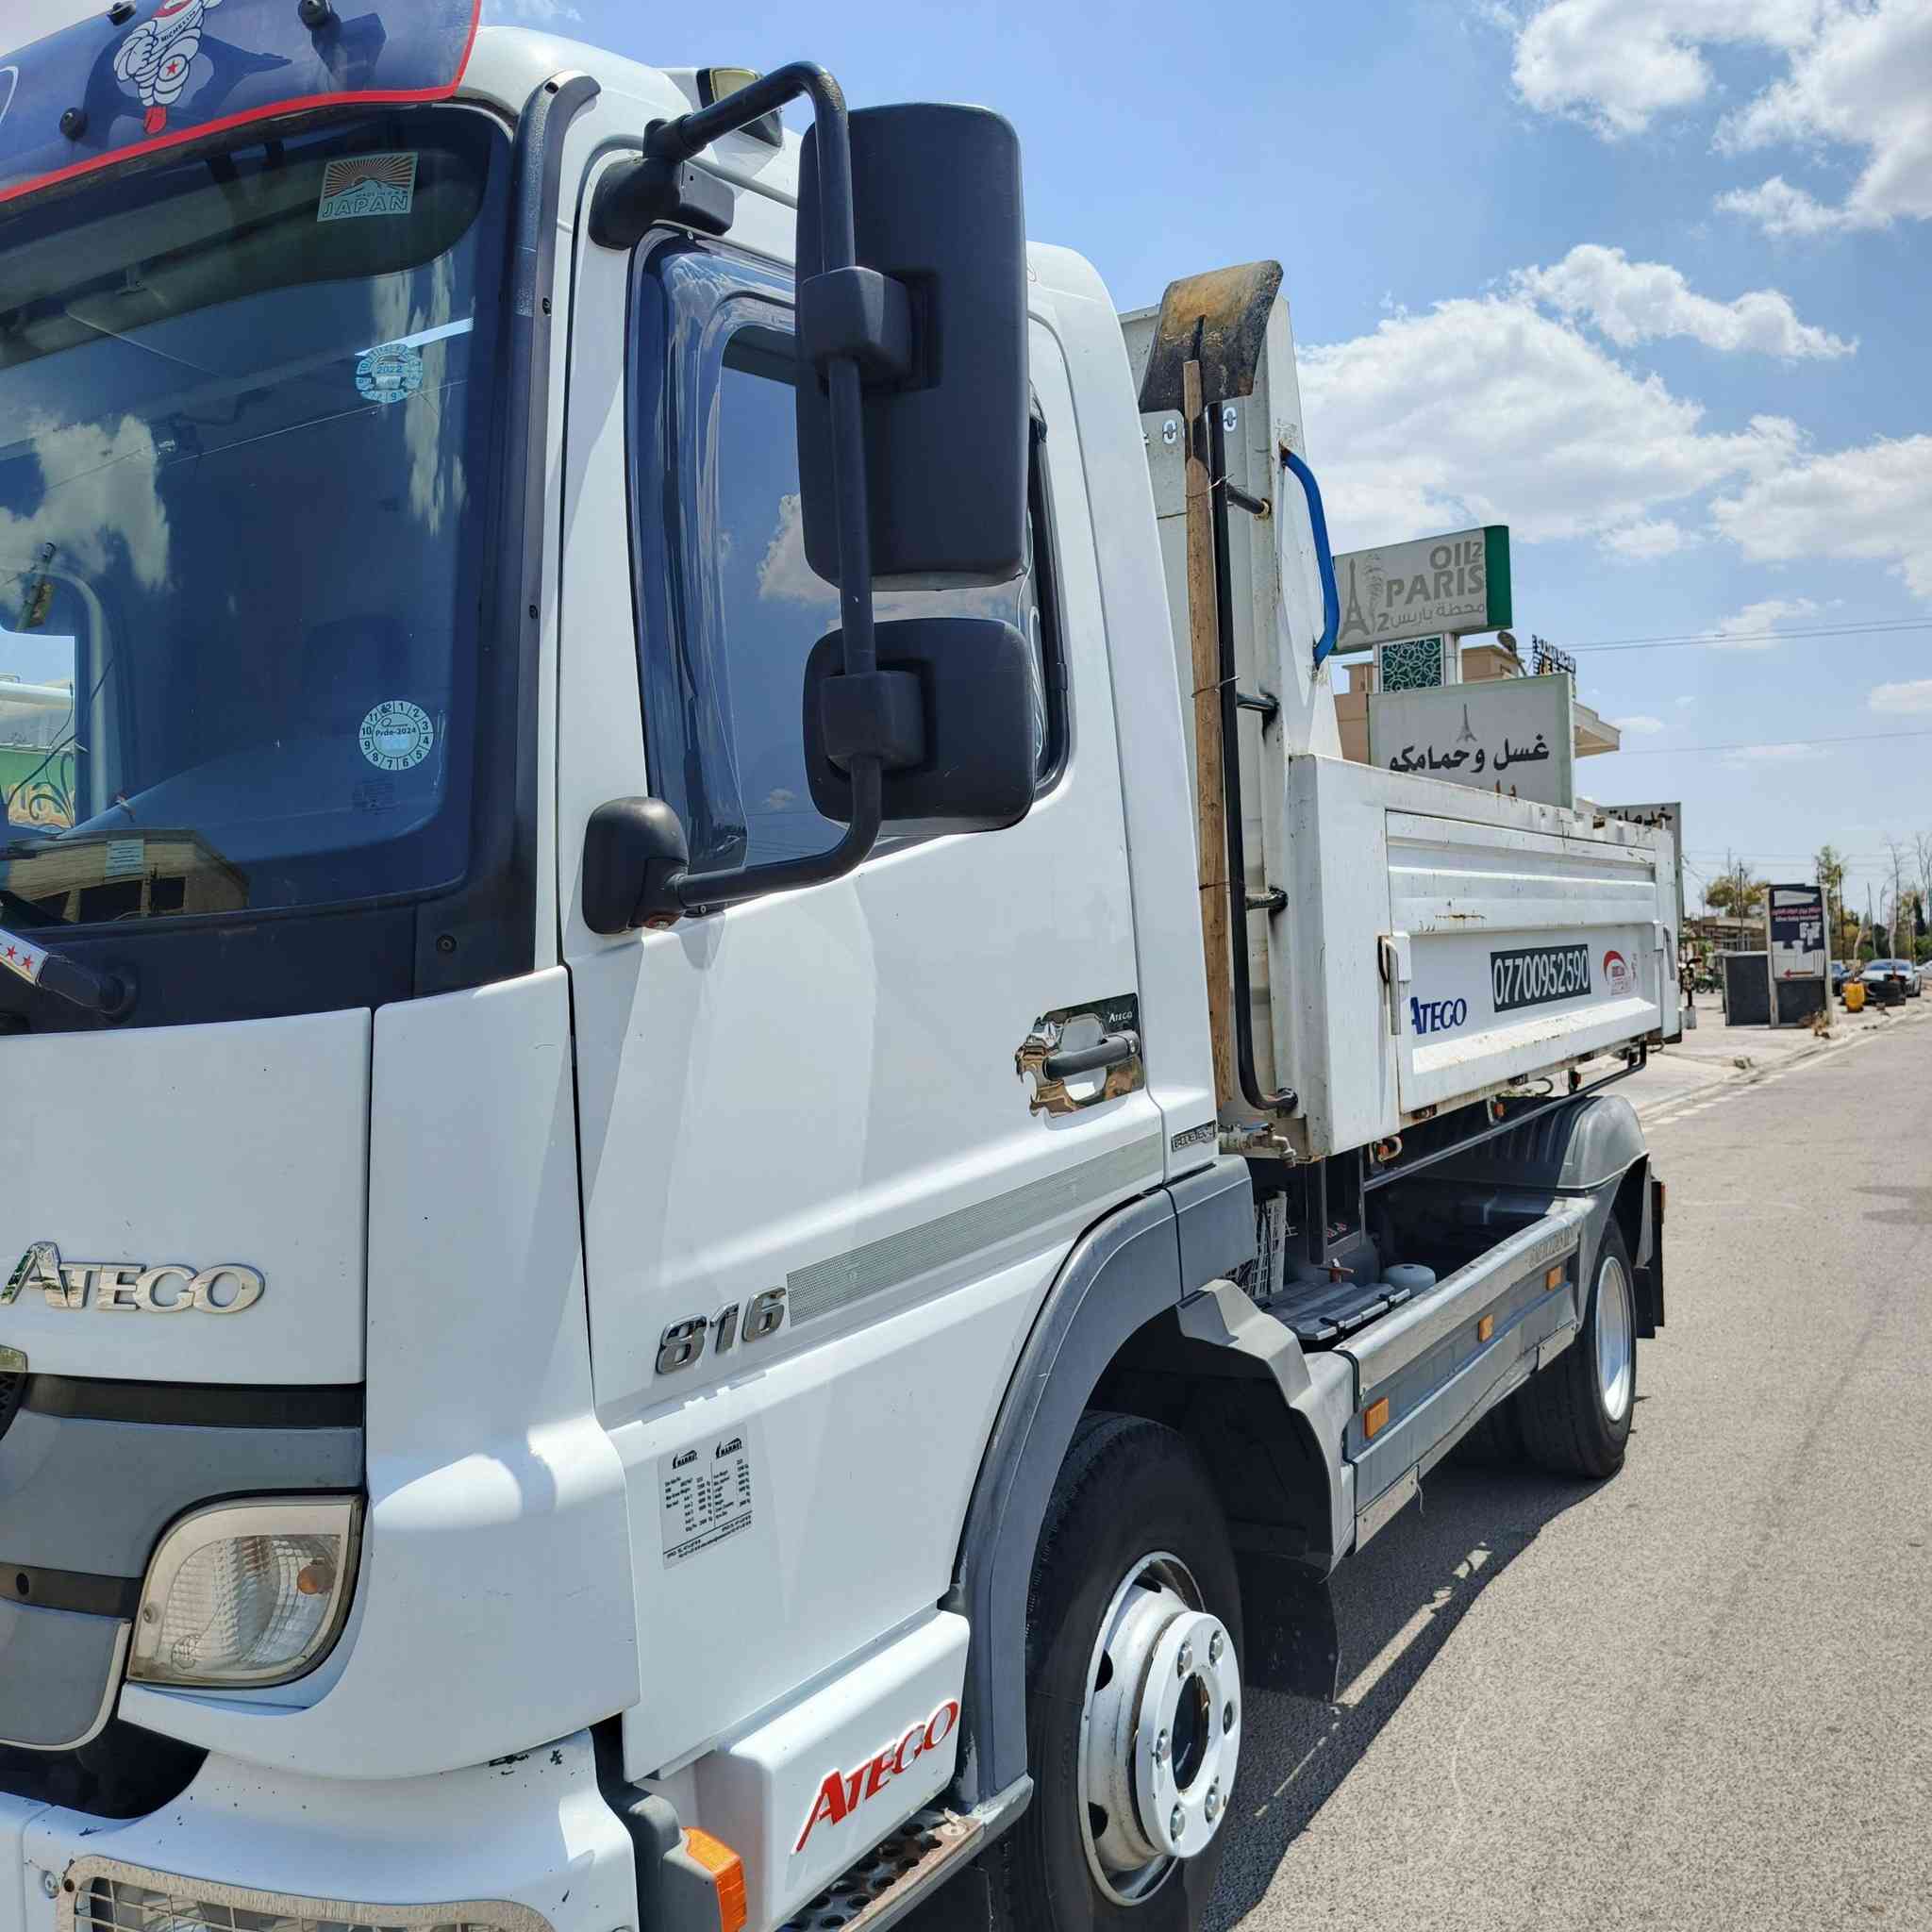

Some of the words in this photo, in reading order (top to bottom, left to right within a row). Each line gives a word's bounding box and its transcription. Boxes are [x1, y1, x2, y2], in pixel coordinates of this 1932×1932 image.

[323, 196, 408, 218] JAPAN
[1429, 541, 1475, 570] OIL
[1386, 564, 1484, 608] PARIS
[1493, 733, 1550, 771] غسل
[1493, 949, 1590, 1006] 07700952590
[0, 1241, 265, 1313] ATEGO
[656, 1286, 787, 1374] 816
[794, 1700, 958, 1853] ATEGO
